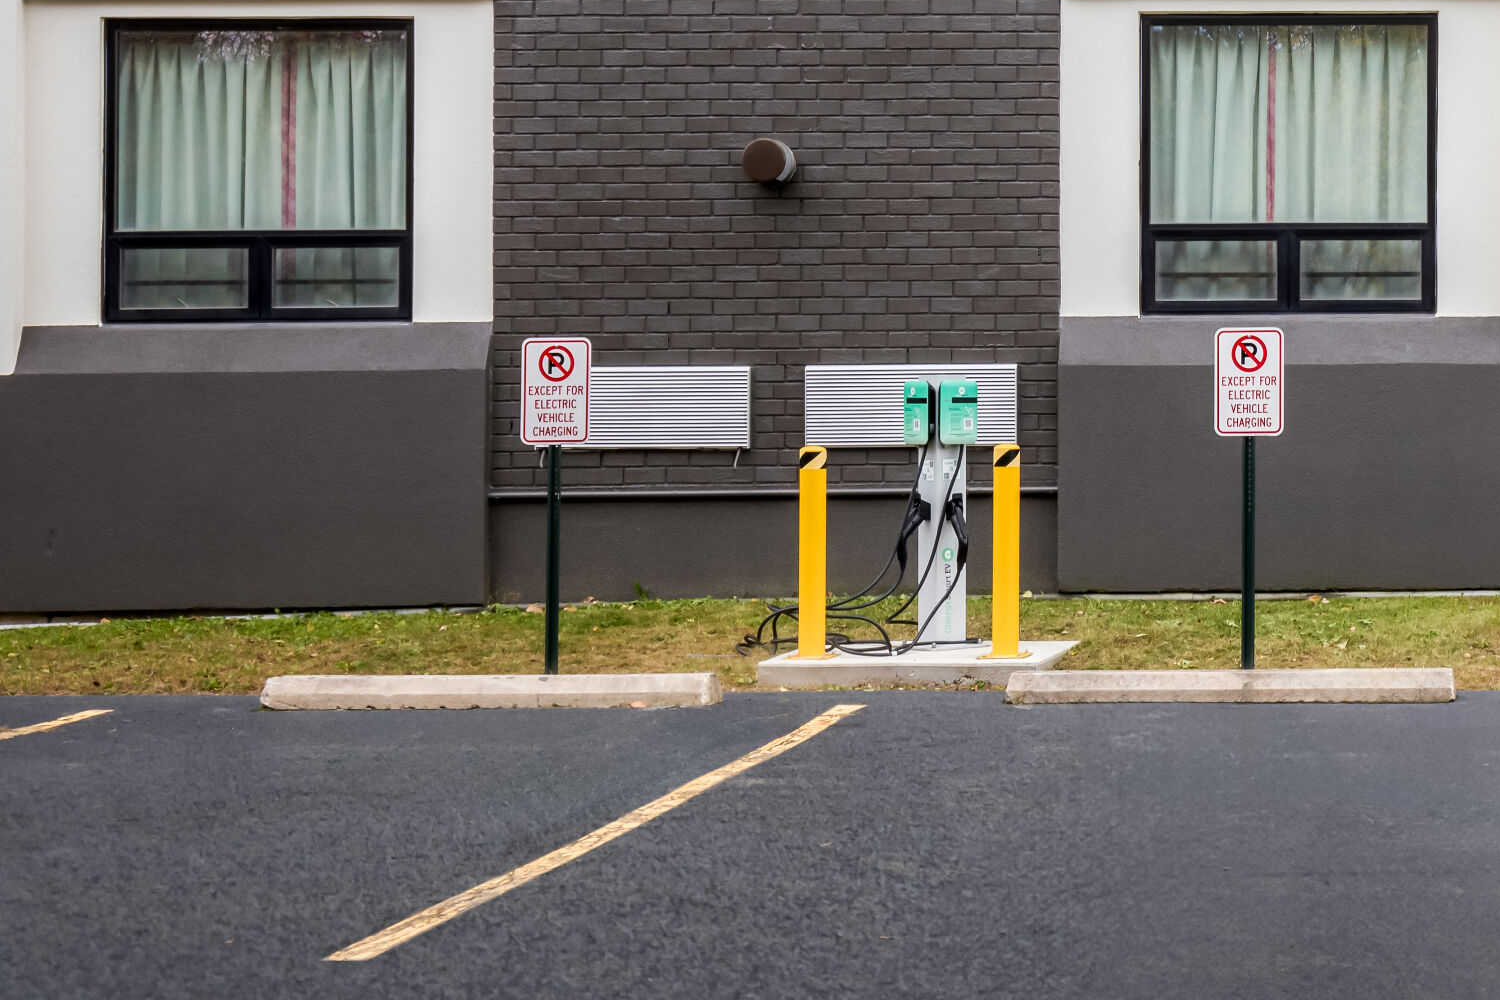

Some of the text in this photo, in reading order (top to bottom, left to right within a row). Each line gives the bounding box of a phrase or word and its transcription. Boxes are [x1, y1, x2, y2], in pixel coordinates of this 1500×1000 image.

[1221, 376, 1277, 387] EXCEPT FOR
[528, 385, 584, 396] EXCEPT FOR
[1228, 390, 1271, 400] ELECTRIC
[534, 399, 577, 409] ELECTRIC
[1230, 403, 1268, 413] VEHICLE
[537, 412, 575, 423] VEHICLE
[1226, 417, 1272, 428] CHARGING
[532, 426, 578, 437] CHARGING
